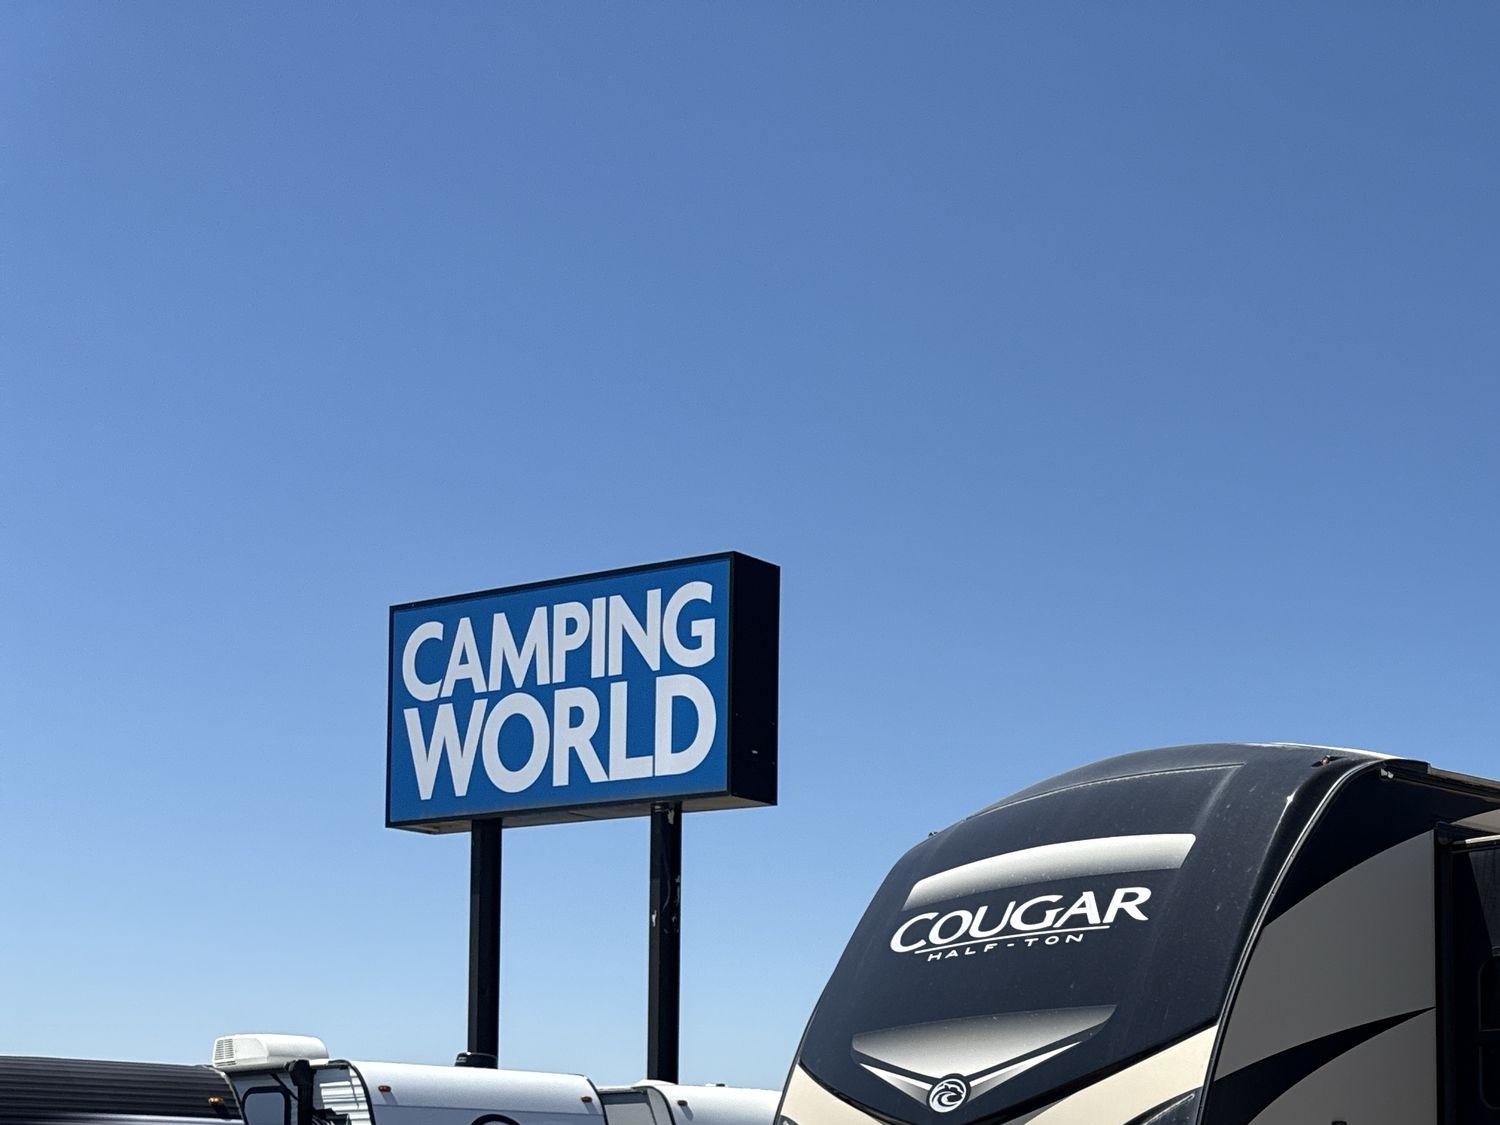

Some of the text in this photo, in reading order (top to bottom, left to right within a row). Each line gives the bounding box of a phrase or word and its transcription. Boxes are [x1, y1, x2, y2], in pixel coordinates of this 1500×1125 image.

[402, 581, 716, 702] CAMPING
[403, 673, 717, 801] WORLD
[890, 886, 1152, 953] COUGAR
[927, 933, 1084, 962] HALF-TON
